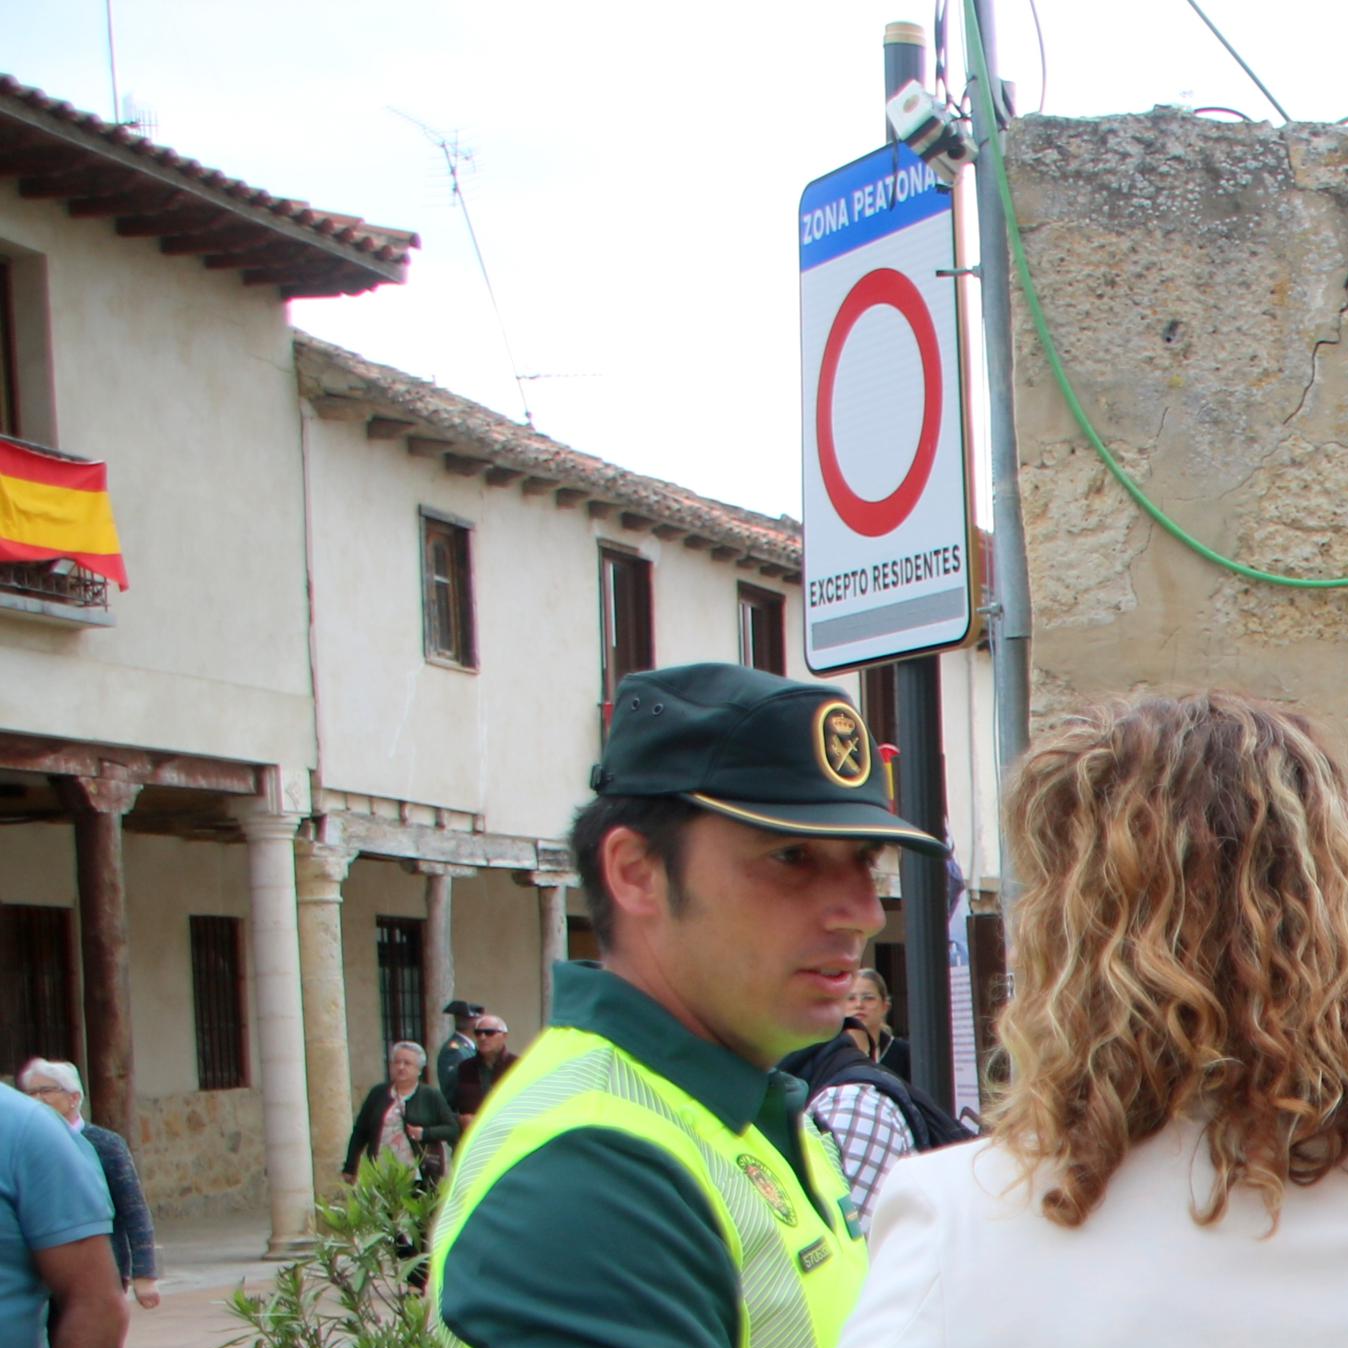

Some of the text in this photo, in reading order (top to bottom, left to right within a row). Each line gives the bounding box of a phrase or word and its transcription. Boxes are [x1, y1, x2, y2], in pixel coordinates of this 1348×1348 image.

[803, 161, 945, 246] ZONA PEATONA
[810, 543, 961, 608] EXCEPTO RESIDENTES
